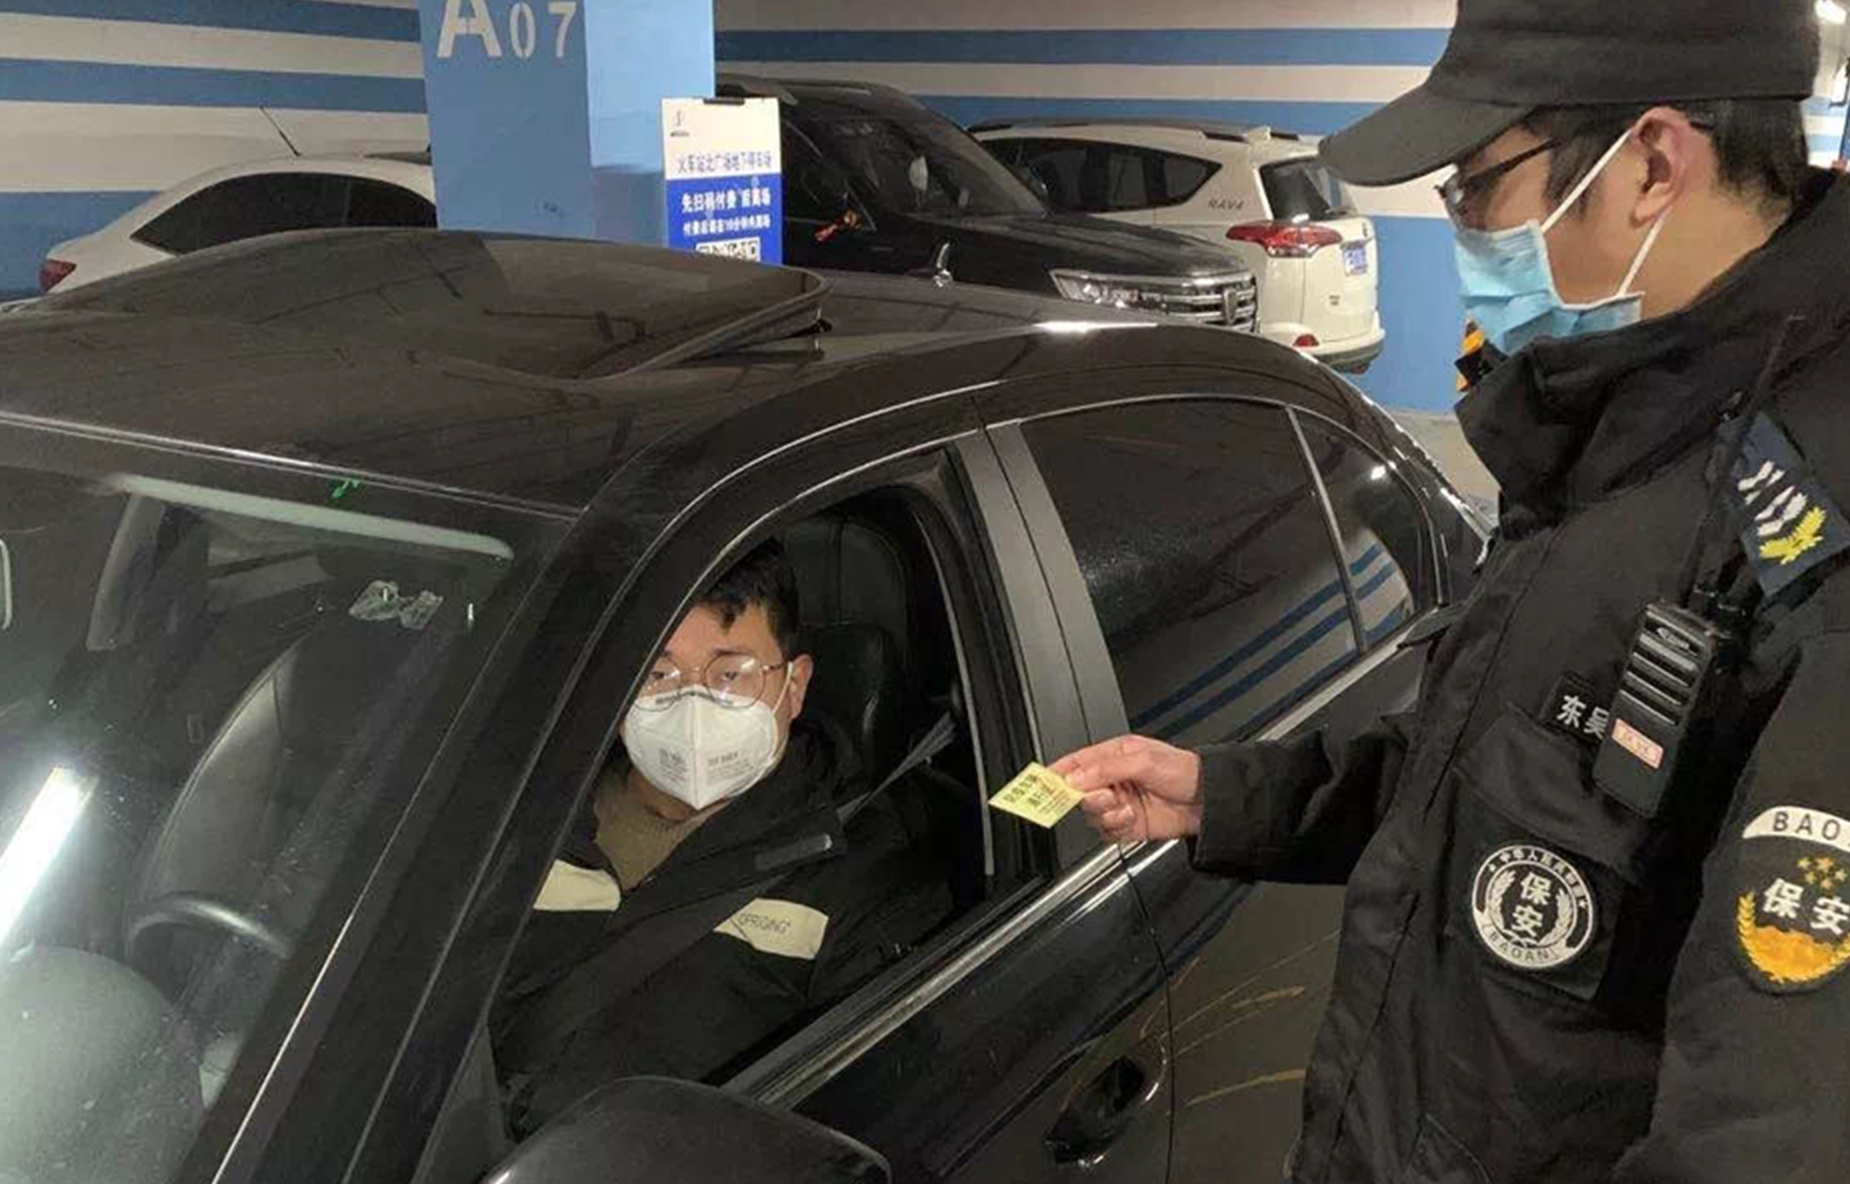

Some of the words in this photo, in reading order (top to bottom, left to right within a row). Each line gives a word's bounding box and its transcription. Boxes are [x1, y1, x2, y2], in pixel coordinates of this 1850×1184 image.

[1772, 810, 1850, 848] BAO
[1511, 871, 1552, 938] 保安
[1762, 877, 1850, 935] 保安
[1488, 931, 1550, 961] BAOAN
